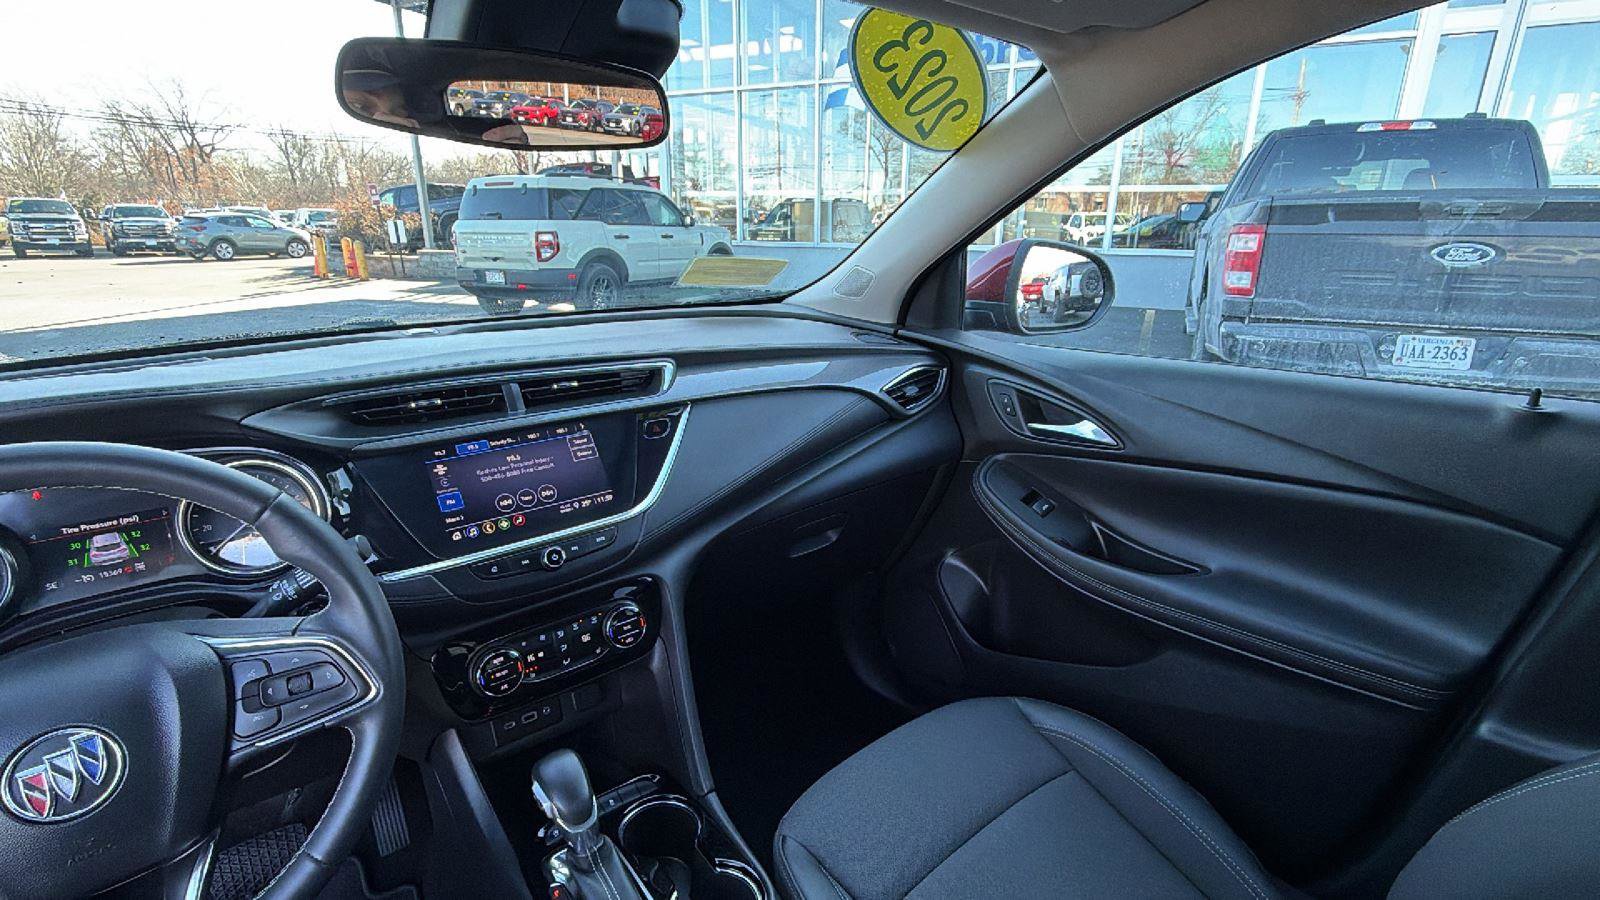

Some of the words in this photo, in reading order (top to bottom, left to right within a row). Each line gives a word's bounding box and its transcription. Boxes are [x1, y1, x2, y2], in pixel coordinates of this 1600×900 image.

[1444, 247, 1483, 262] Ford
[1417, 336, 1455, 345] VIRGINIA
[1399, 343, 1469, 361] UAA-2363
[61, 526, 79, 535] Tire
[80, 519, 118, 532] Pressure
[202, 524, 213, 533] 20
[131, 530, 141, 538] 32
[69, 542, 81, 550] 30
[67, 558, 79, 567] 31
